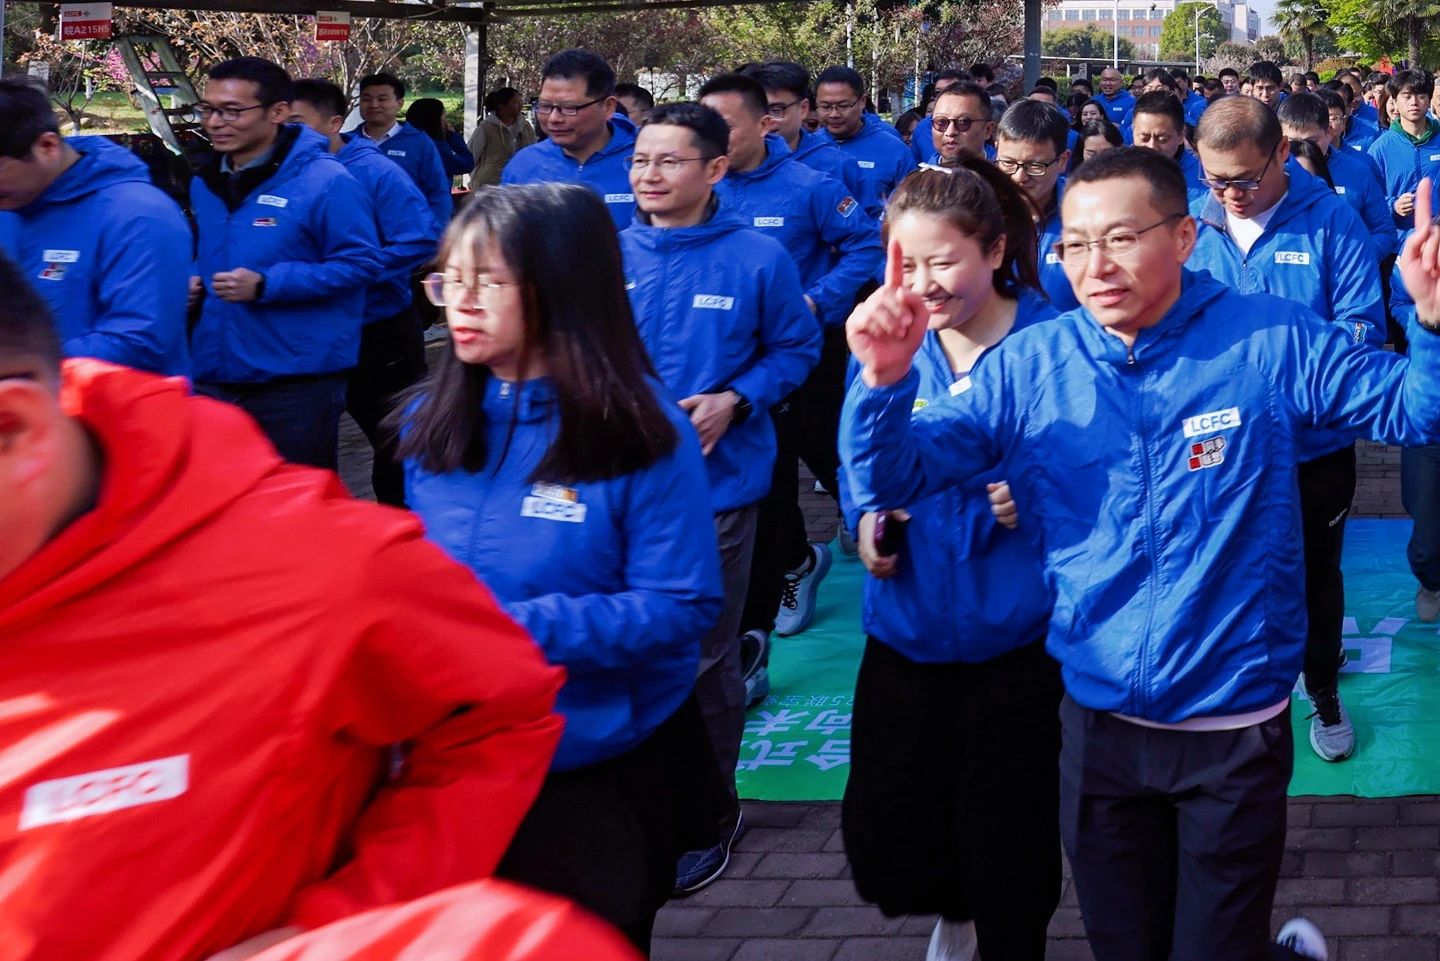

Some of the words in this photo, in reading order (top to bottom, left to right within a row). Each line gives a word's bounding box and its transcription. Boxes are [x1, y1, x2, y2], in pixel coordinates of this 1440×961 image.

[1279, 253, 1304, 262] LCFC
[699, 297, 727, 307] LCFC
[1191, 413, 1231, 432] LCFC
